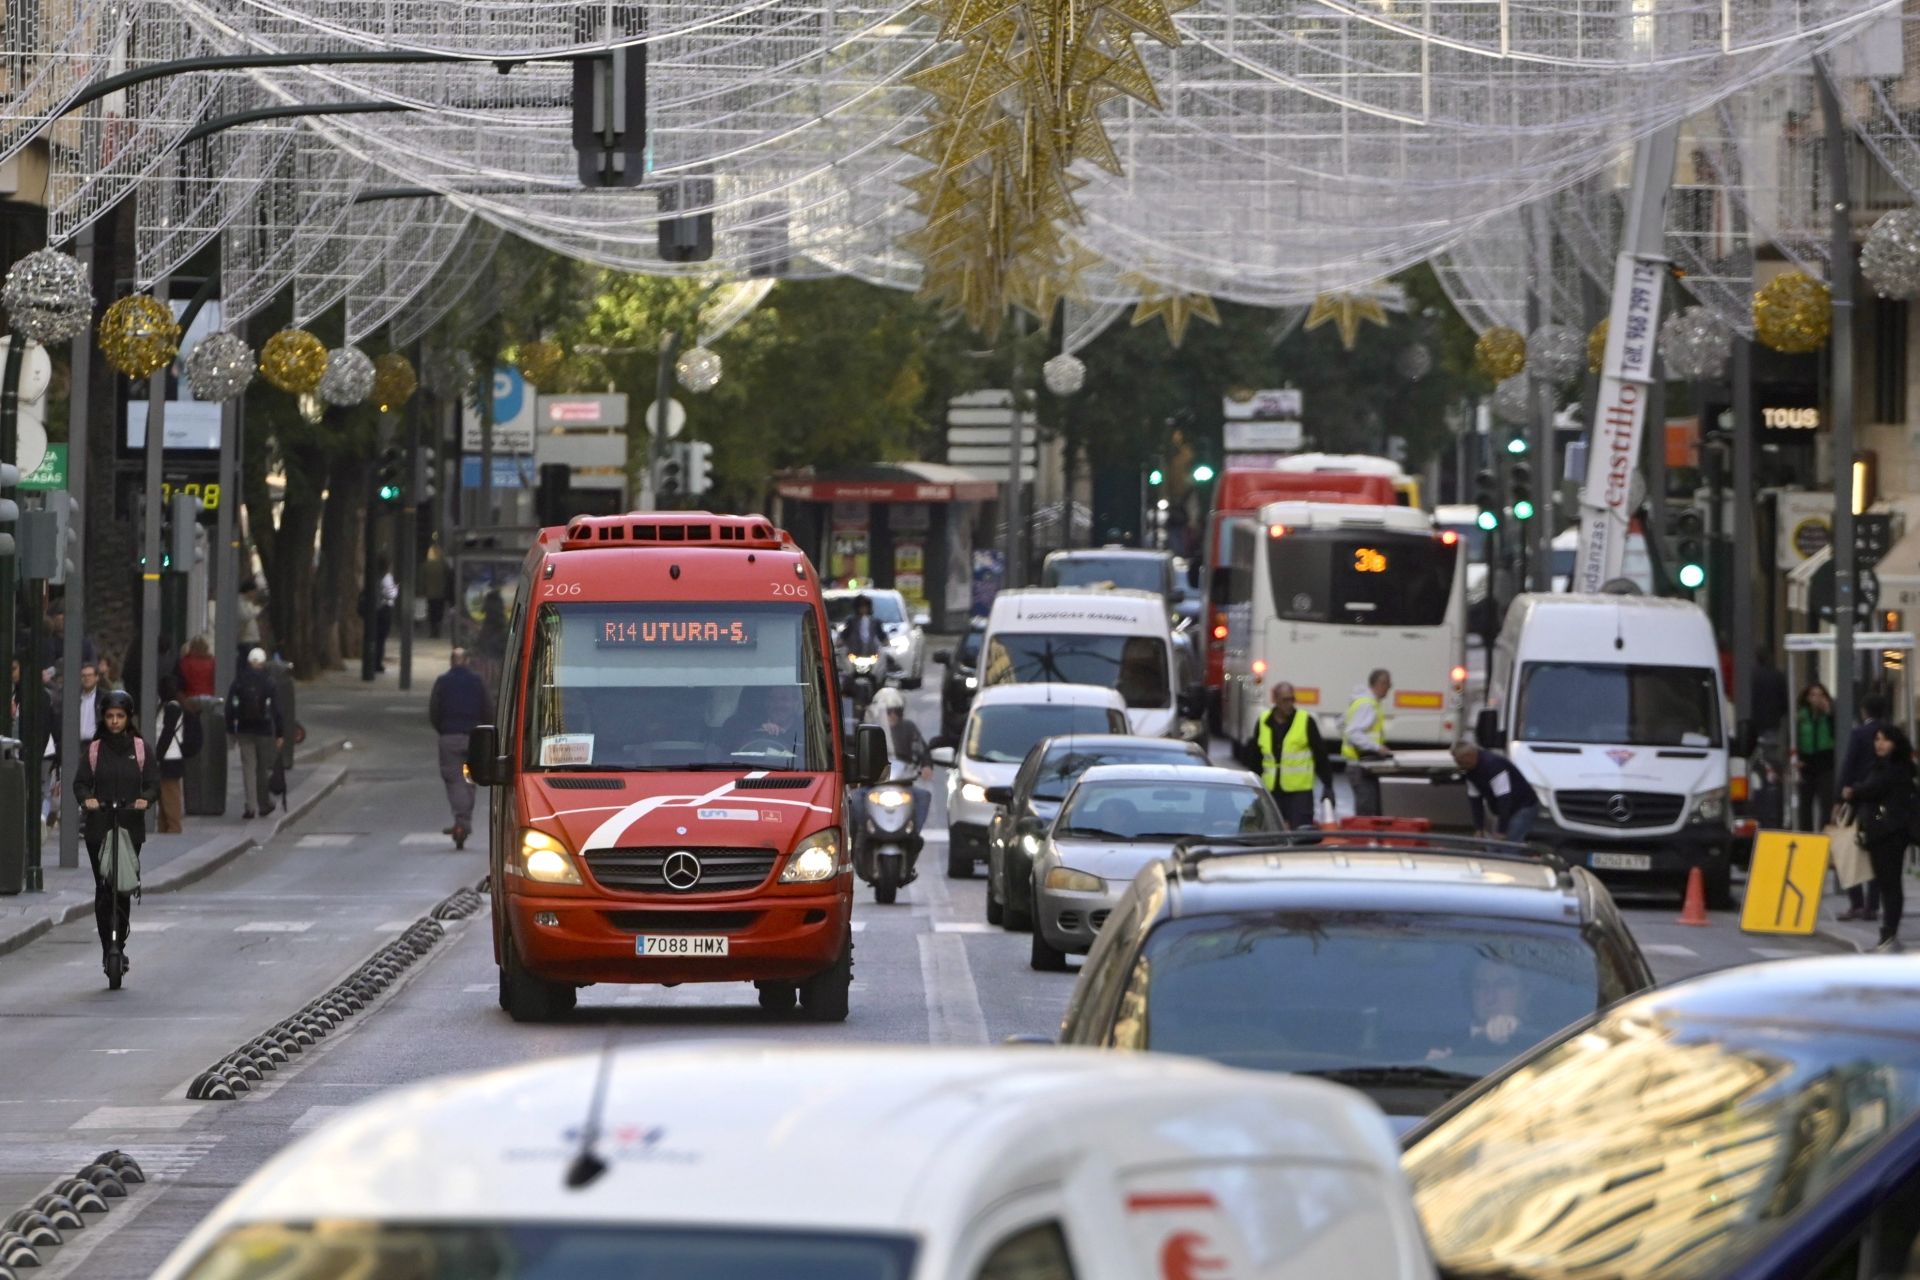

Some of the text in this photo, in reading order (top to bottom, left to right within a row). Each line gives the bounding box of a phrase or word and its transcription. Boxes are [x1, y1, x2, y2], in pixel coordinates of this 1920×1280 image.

[1630, 287, 1650, 312] 299
[1626, 315, 1648, 339] 968
[1762, 408, 1818, 429] TOUS
[1605, 384, 1638, 507] castillo
[544, 583, 582, 597] 206
[770, 583, 808, 597] 206
[605, 622, 637, 641] R14
[647, 938, 724, 953] 7088 HMX
